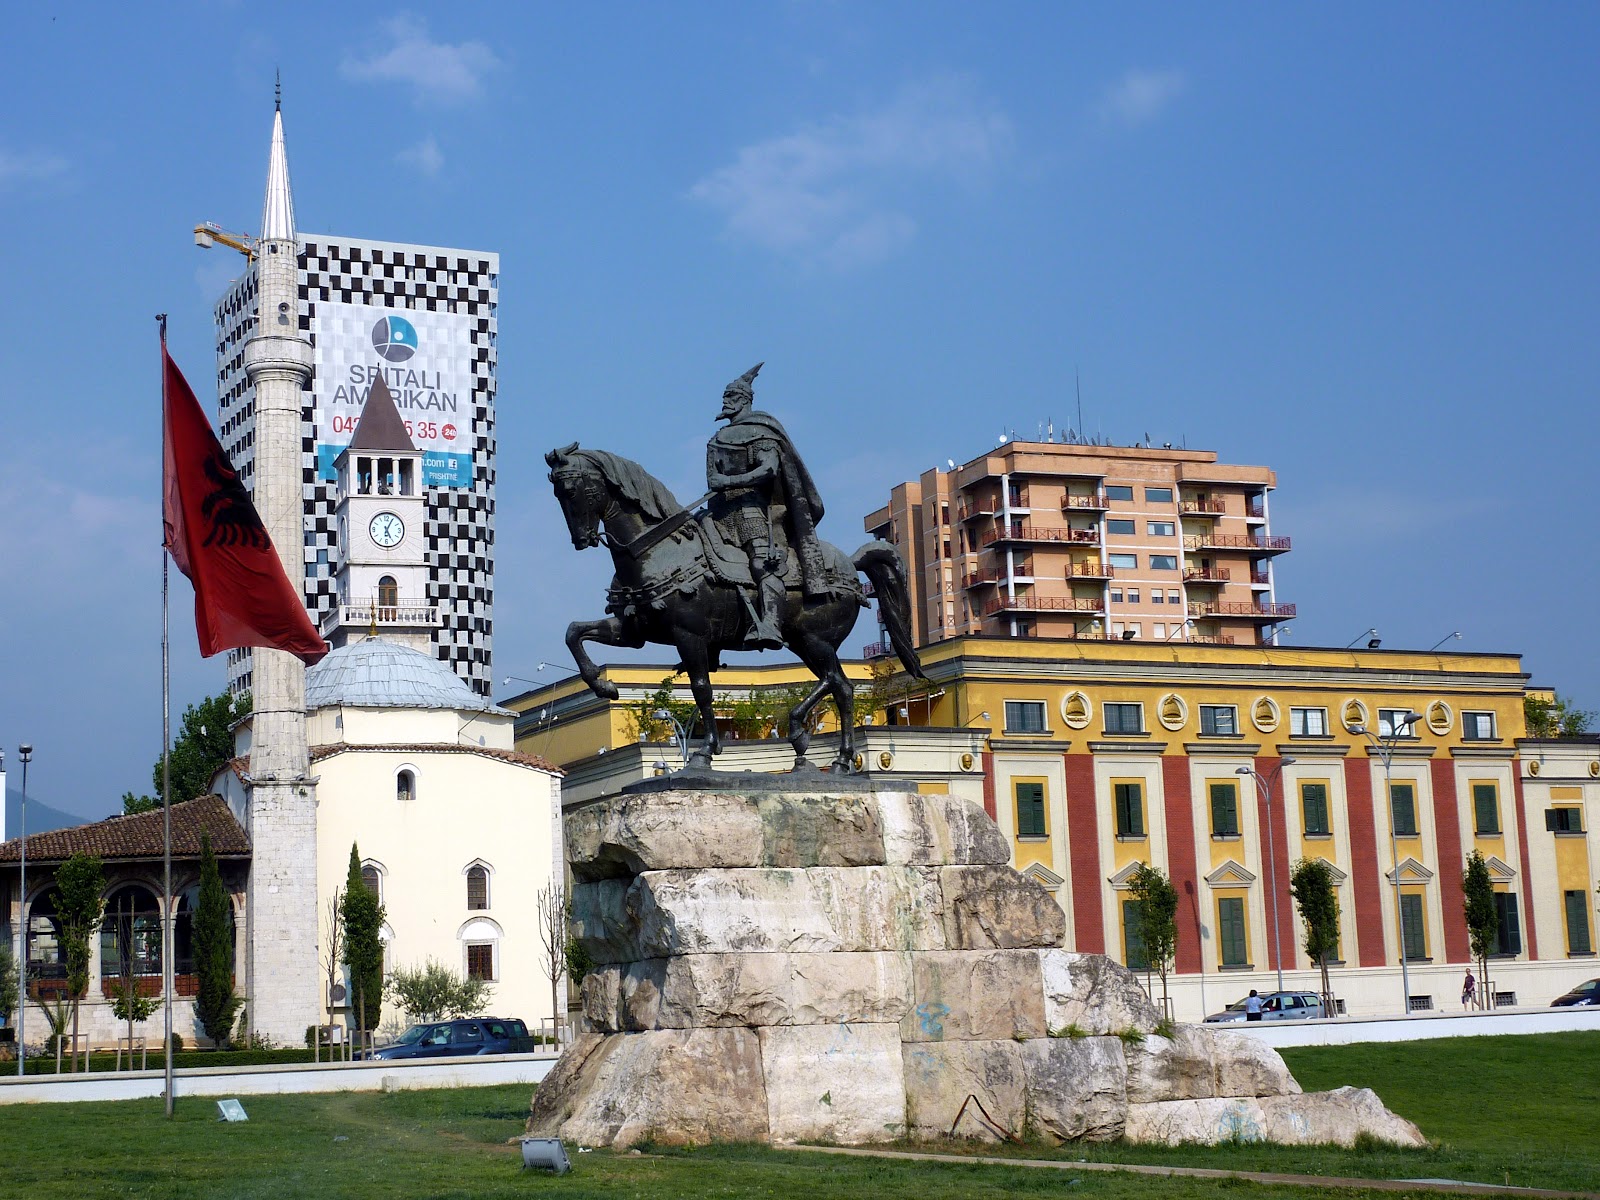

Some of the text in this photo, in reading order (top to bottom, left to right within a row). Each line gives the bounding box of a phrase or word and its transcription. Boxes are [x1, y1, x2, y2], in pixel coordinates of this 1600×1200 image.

[349, 364, 441, 390] SPITALI
[332, 384, 457, 412] AMRIKAN
[417, 421, 437, 439] 35
